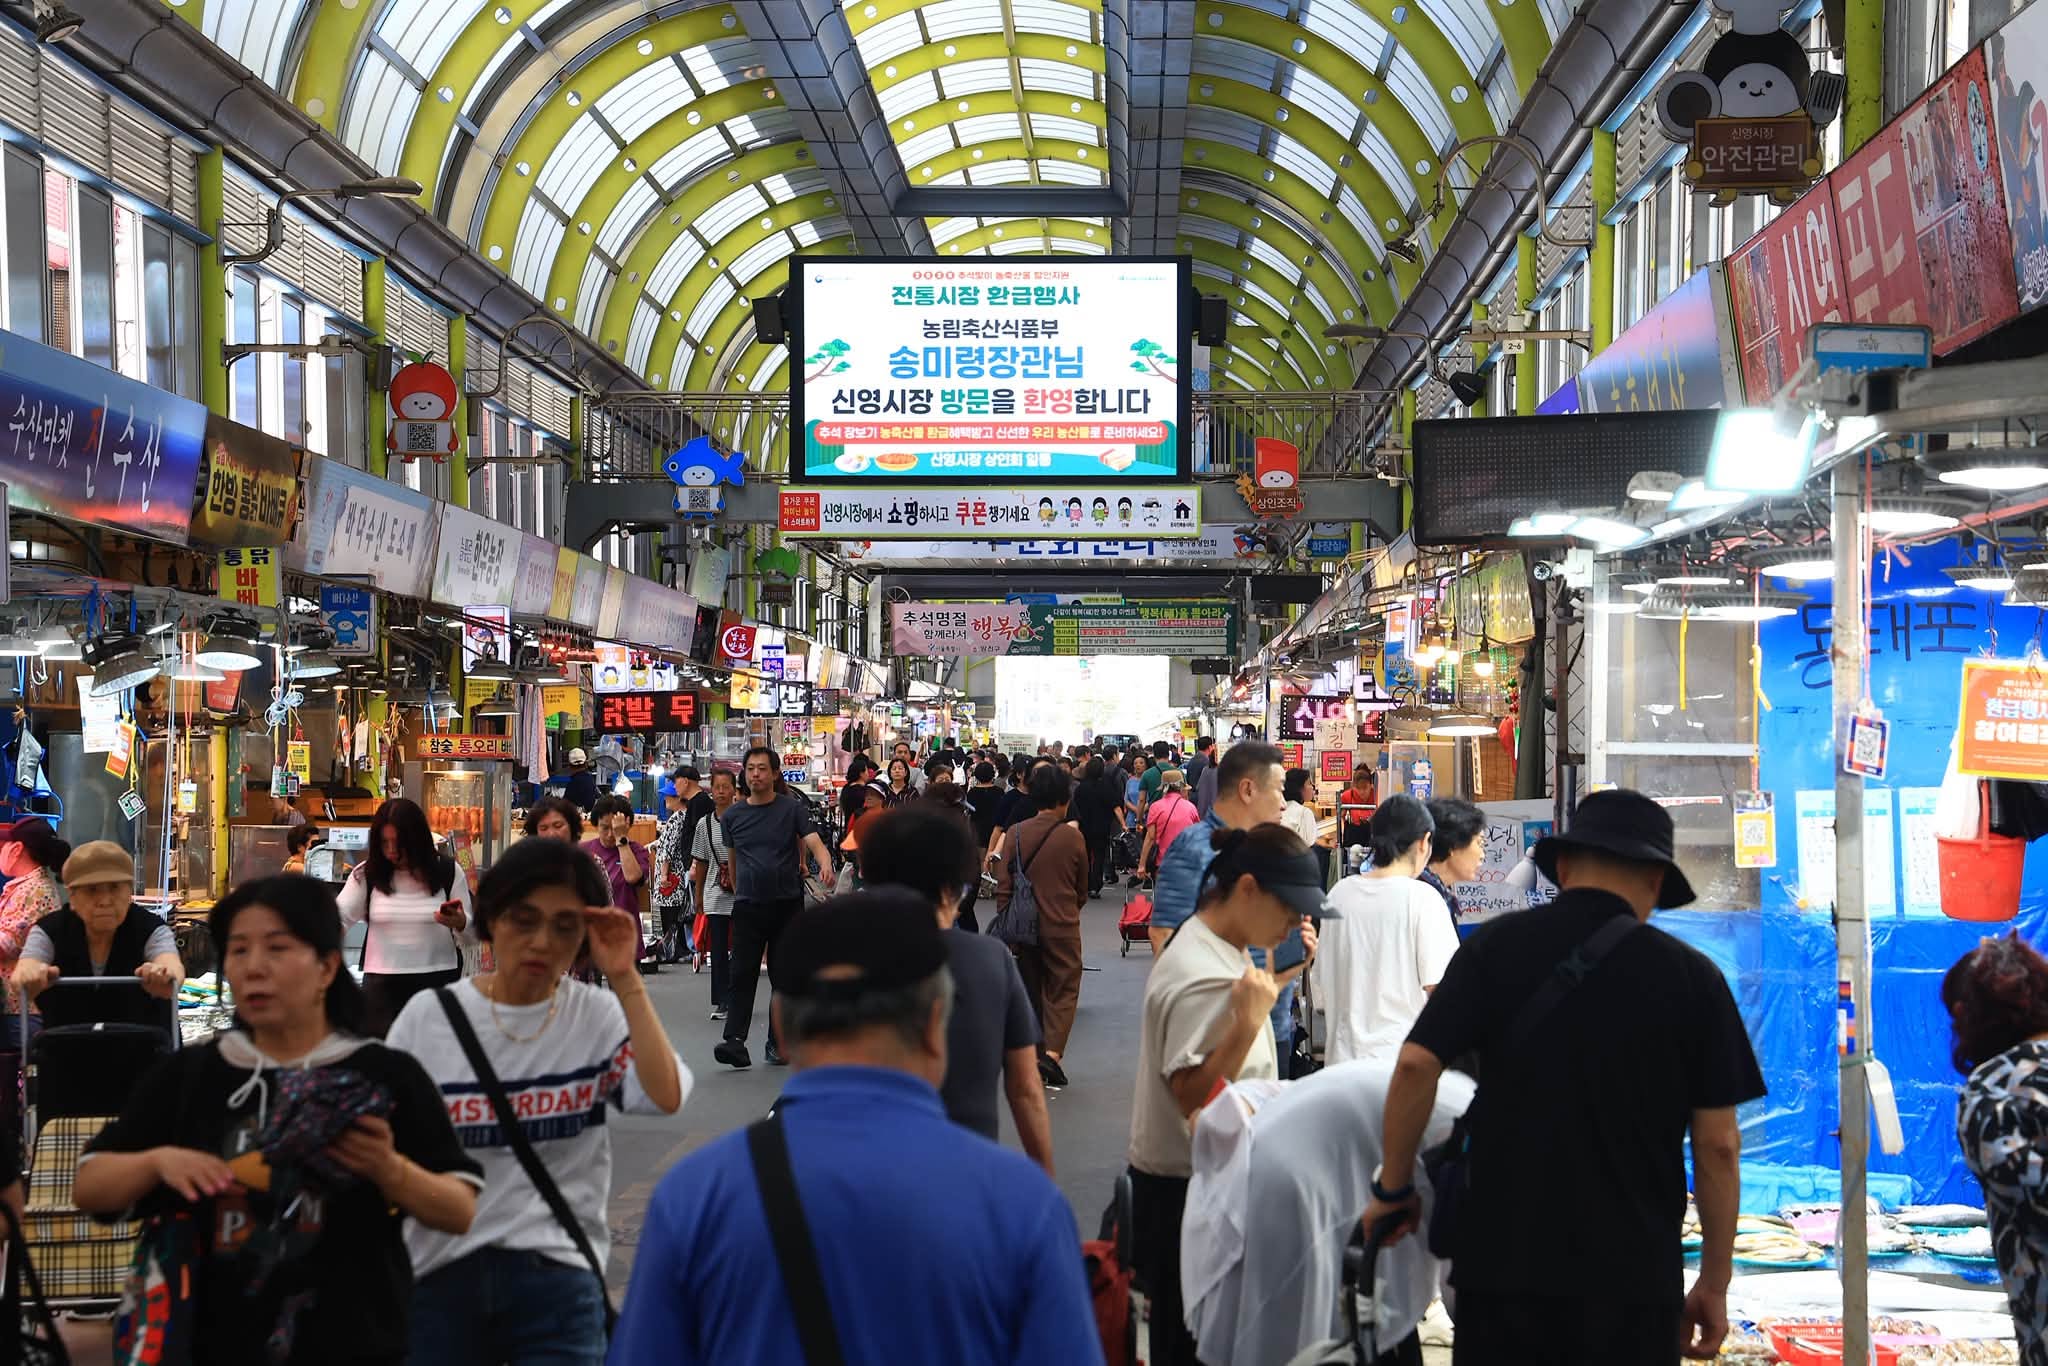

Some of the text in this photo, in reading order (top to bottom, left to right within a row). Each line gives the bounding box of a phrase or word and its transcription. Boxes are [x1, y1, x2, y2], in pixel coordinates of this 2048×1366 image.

[1731, 127, 1774, 140] 신영시장
[1702, 143, 1805, 173] 안전관리
[891, 286, 1080, 305] 전통시장 환급행사
[922, 319, 1059, 339] 농림축산식품부
[889, 345, 1083, 379] 송미령장관님
[832, 388, 1151, 415] 신영시장 방문을 환영합니다
[9, 394, 74, 469] 수산마켓
[819, 426, 841, 439] 추석
[845, 427, 877, 439] 장보기
[996, 427, 1029, 439] 신선한
[1032, 427, 1053, 439] 우리
[1104, 427, 1163, 439] 준비하세요!
[823, 502, 883, 523] 신영시장에서
[887, 500, 949, 526] 쇼핑하시고
[1256, 497, 1297, 510] 상인조직
[904, 611, 967, 627] 추석명절
[971, 616, 1014, 640] 행복
[924, 629, 967, 640] 함께라서
[603, 695, 694, 727] 닭발 무
[430, 738, 453, 754] 참숯
[458, 738, 497, 754] 통오리
[447, 1084, 595, 1124] MSTRDAM
